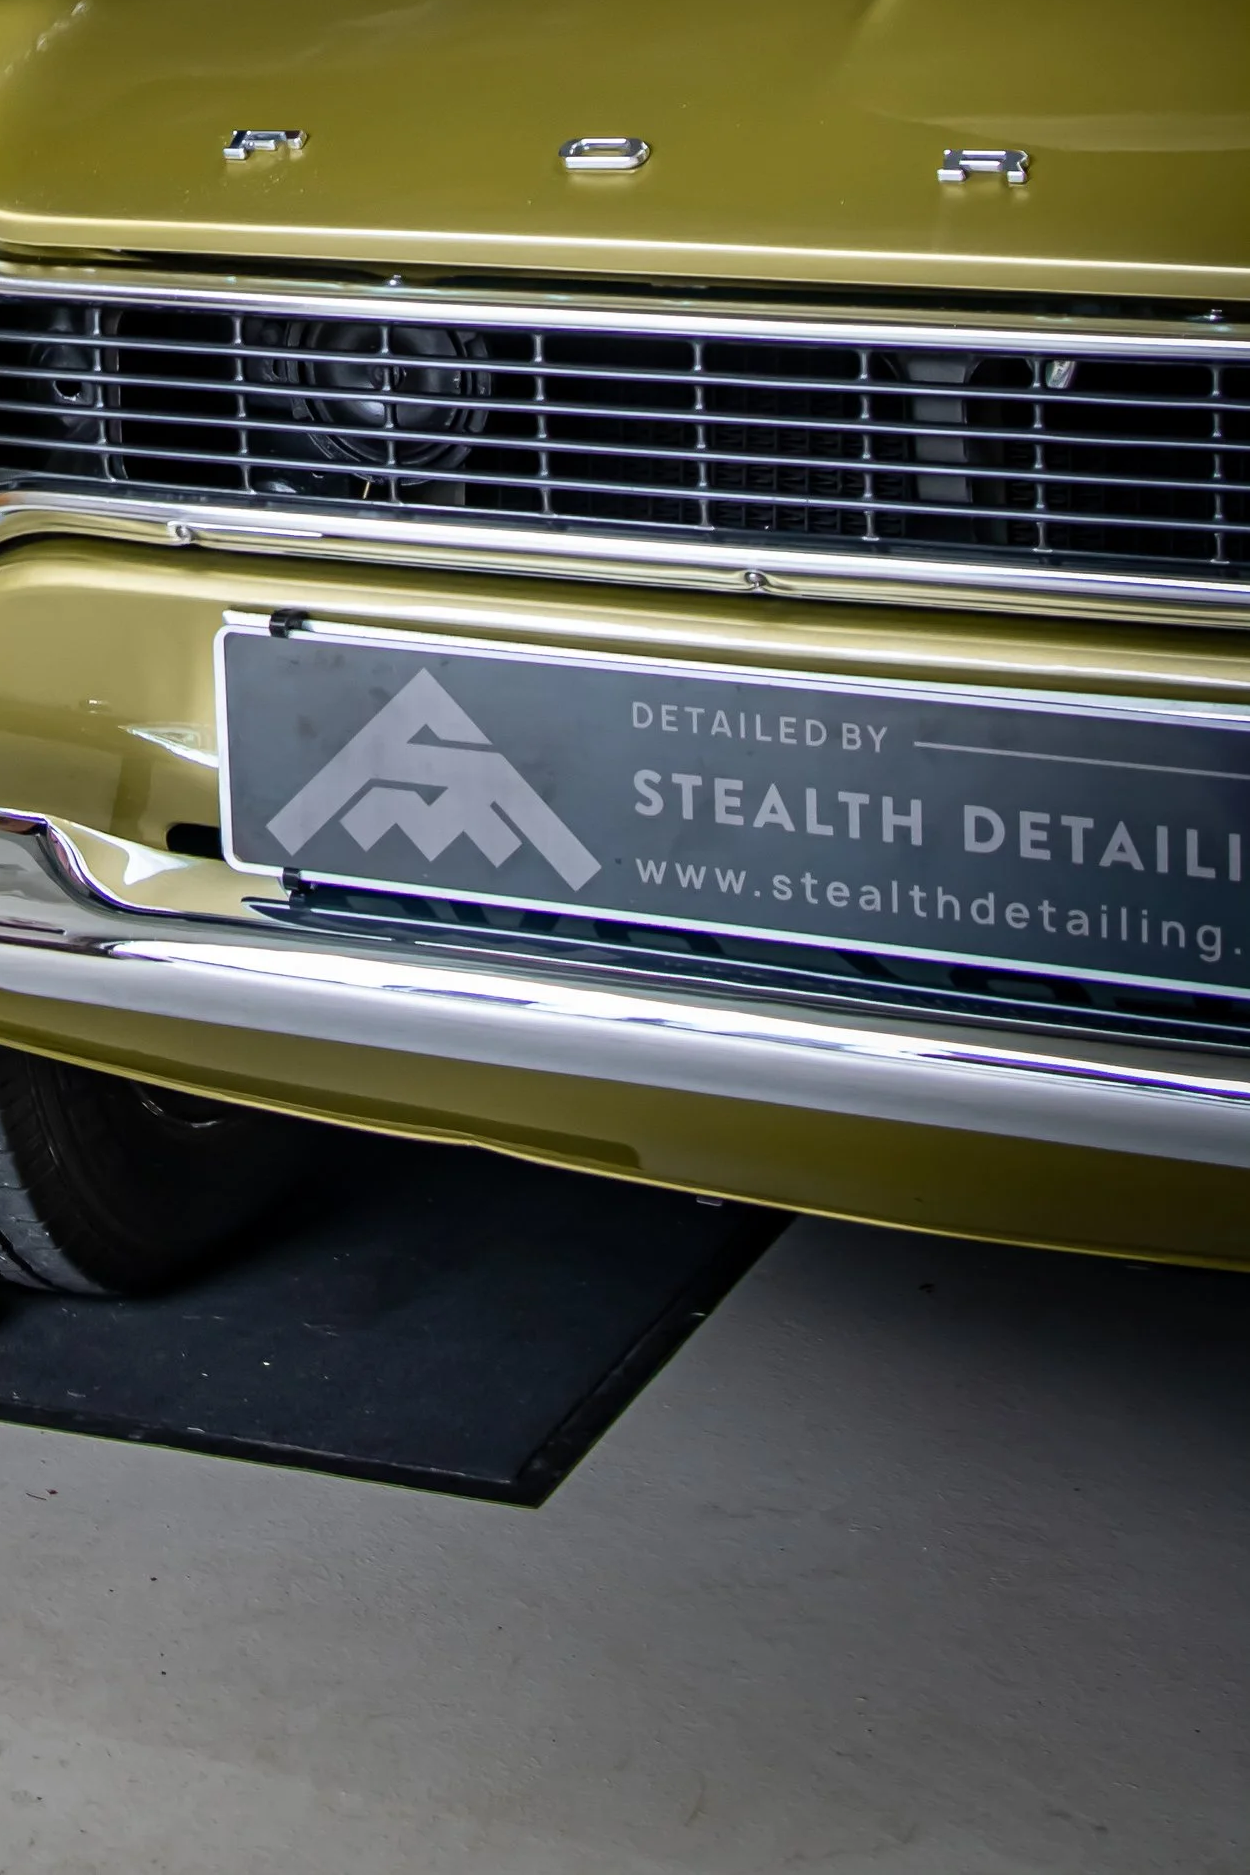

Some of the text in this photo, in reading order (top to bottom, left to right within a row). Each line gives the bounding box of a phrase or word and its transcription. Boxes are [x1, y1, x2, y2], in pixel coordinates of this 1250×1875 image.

[631, 700, 888, 754] DETAILED BY
[633, 768, 1241, 883] STEALTH DETAILI
[635, 857, 1243, 963] www.stealthdetailing.
